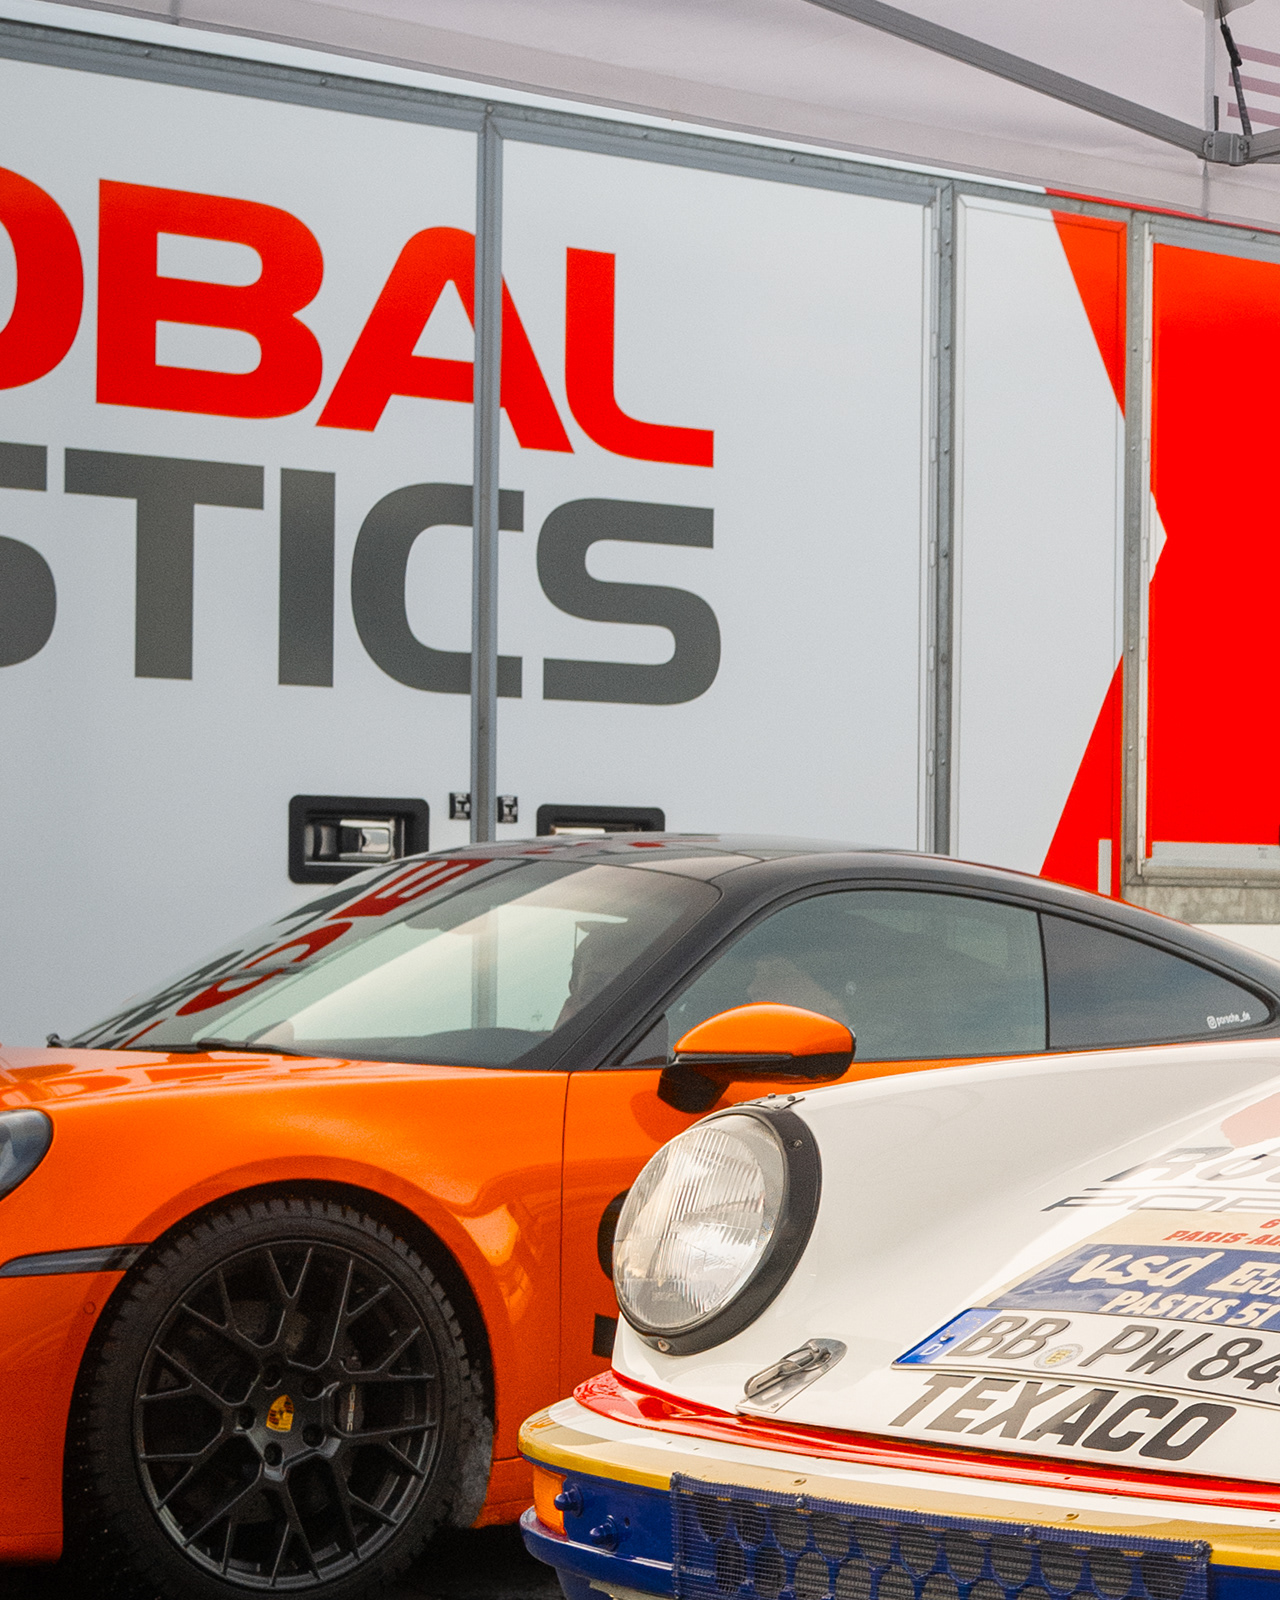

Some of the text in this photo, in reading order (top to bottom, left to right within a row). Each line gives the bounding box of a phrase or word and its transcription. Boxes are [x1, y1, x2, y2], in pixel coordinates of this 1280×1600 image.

[1099, 1290, 1243, 1326] PASTIS
[920, 1343, 943, 1356] D
[946, 1316, 1071, 1359] BB
[1078, 1324, 1215, 1375] PW
[888, 1373, 1238, 1461] TEXACO
